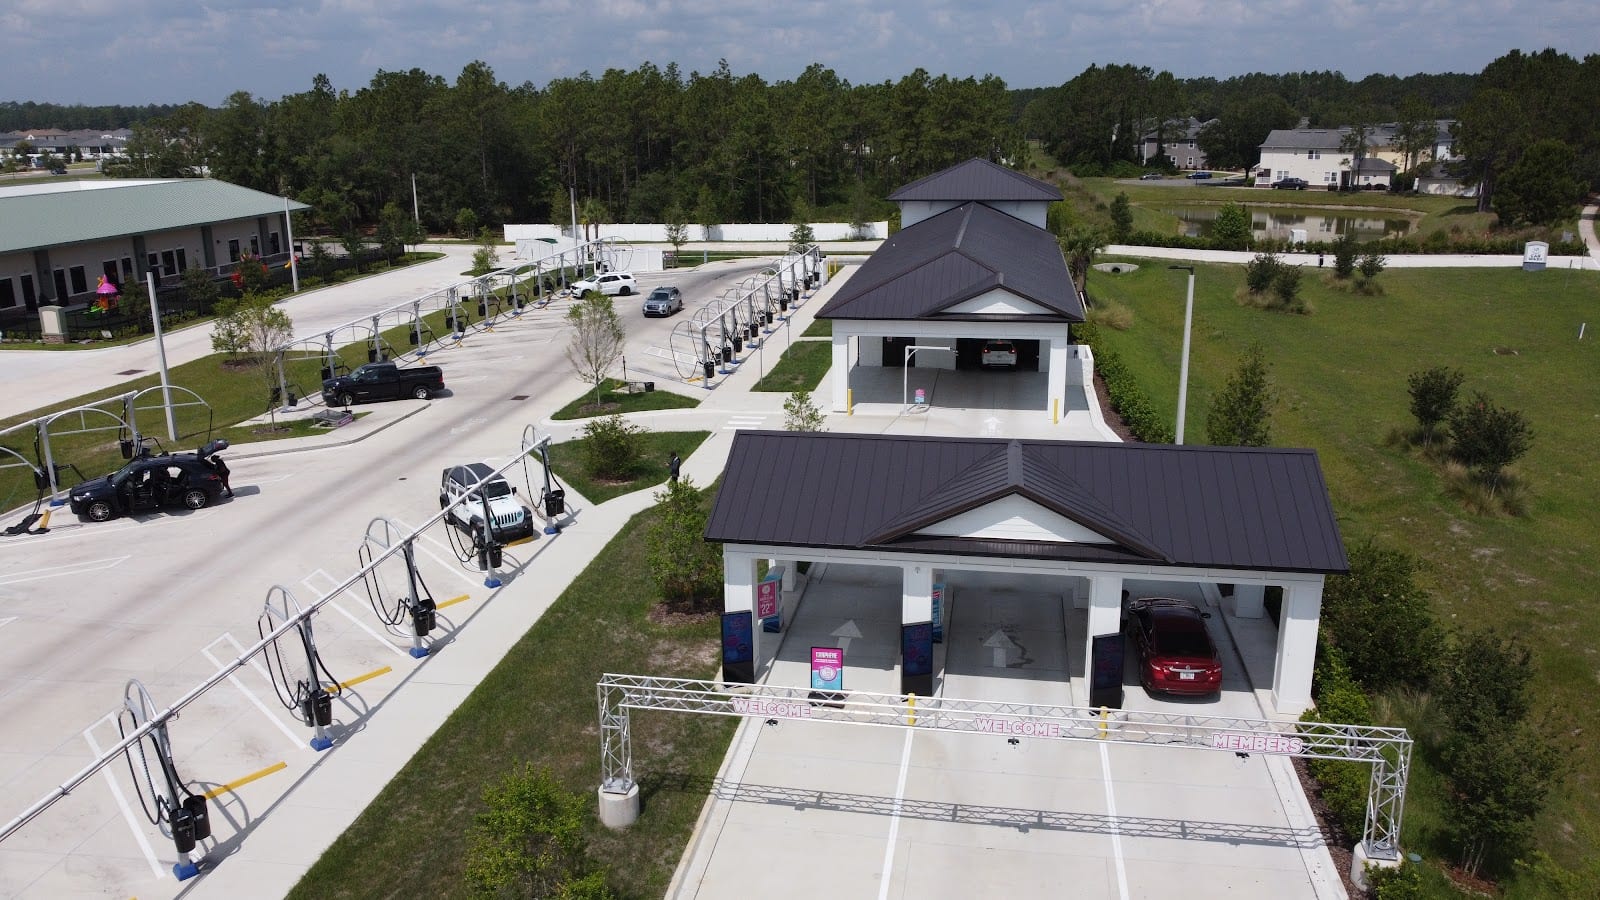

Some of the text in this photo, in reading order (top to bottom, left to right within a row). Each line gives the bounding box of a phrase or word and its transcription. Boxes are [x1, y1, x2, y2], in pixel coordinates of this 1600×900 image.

[732, 698, 811, 718] WELCOME
[976, 717, 1060, 737] WELCOME
[1212, 733, 1302, 754] MEMBERS
